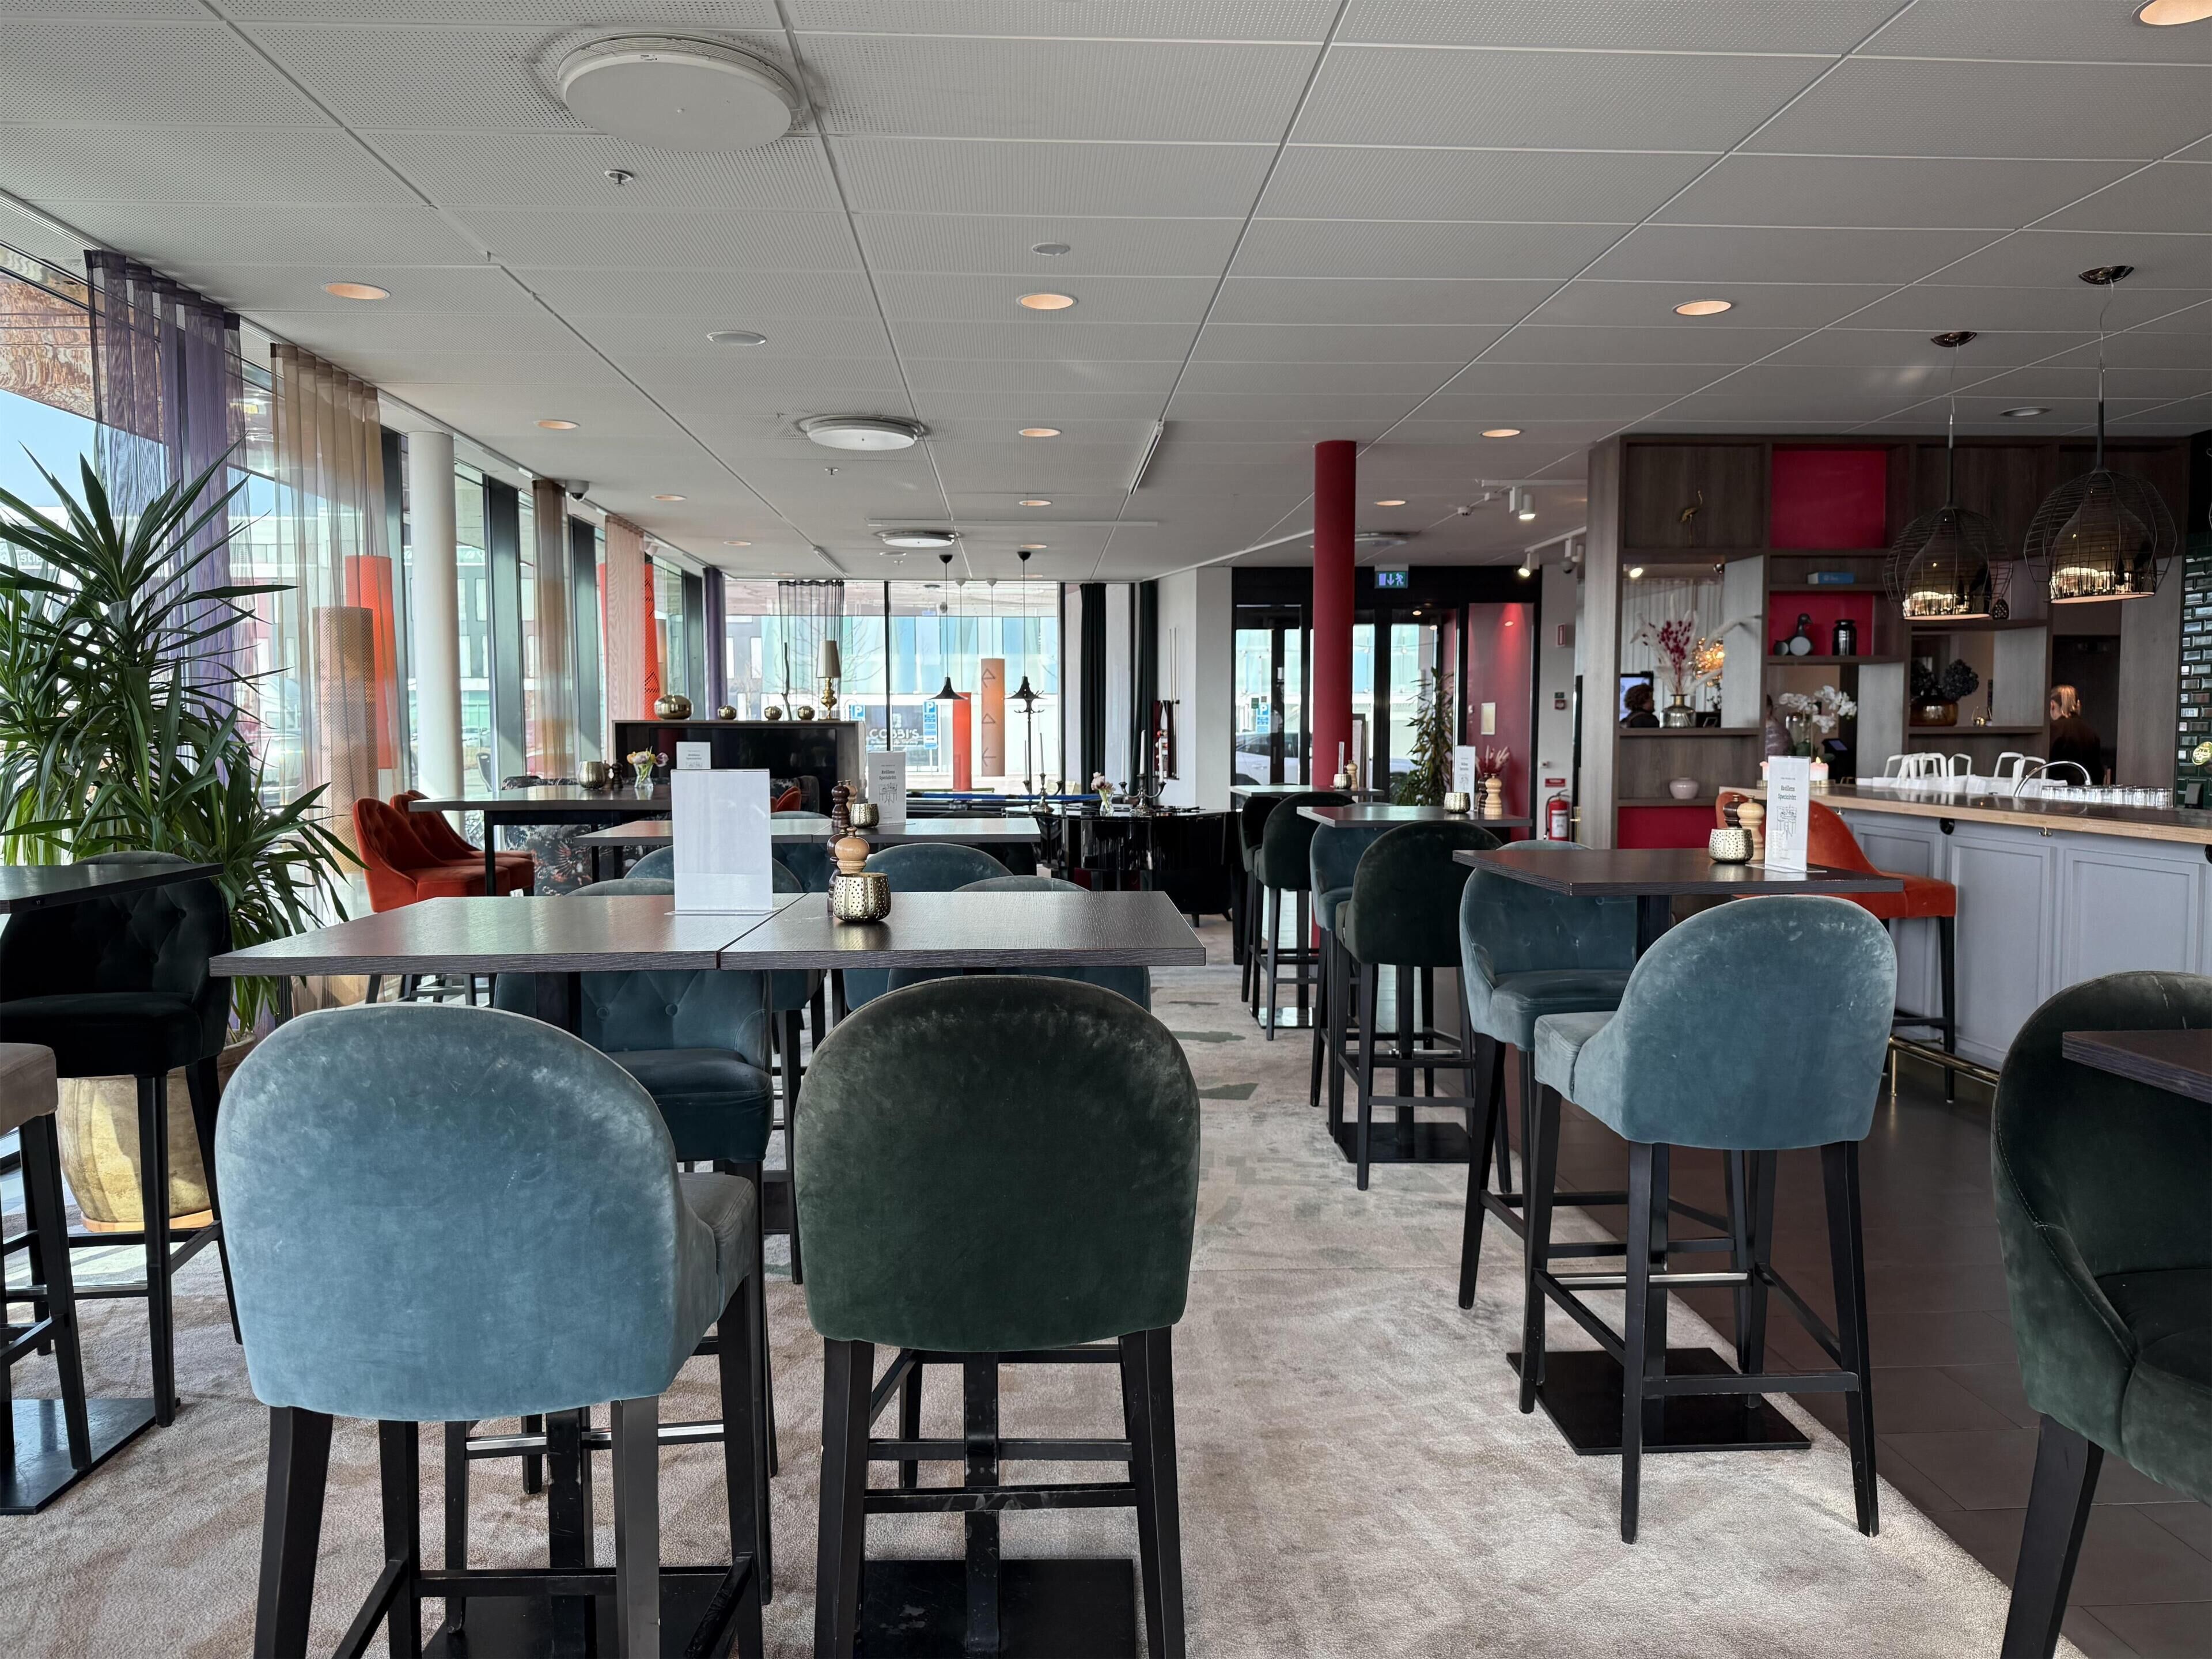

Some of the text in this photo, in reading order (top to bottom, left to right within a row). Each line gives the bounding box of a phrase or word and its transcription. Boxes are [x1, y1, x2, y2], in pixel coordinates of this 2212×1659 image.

[854, 706, 862, 717] P
[926, 702, 934, 713] P
[1260, 704, 1267, 715] P
